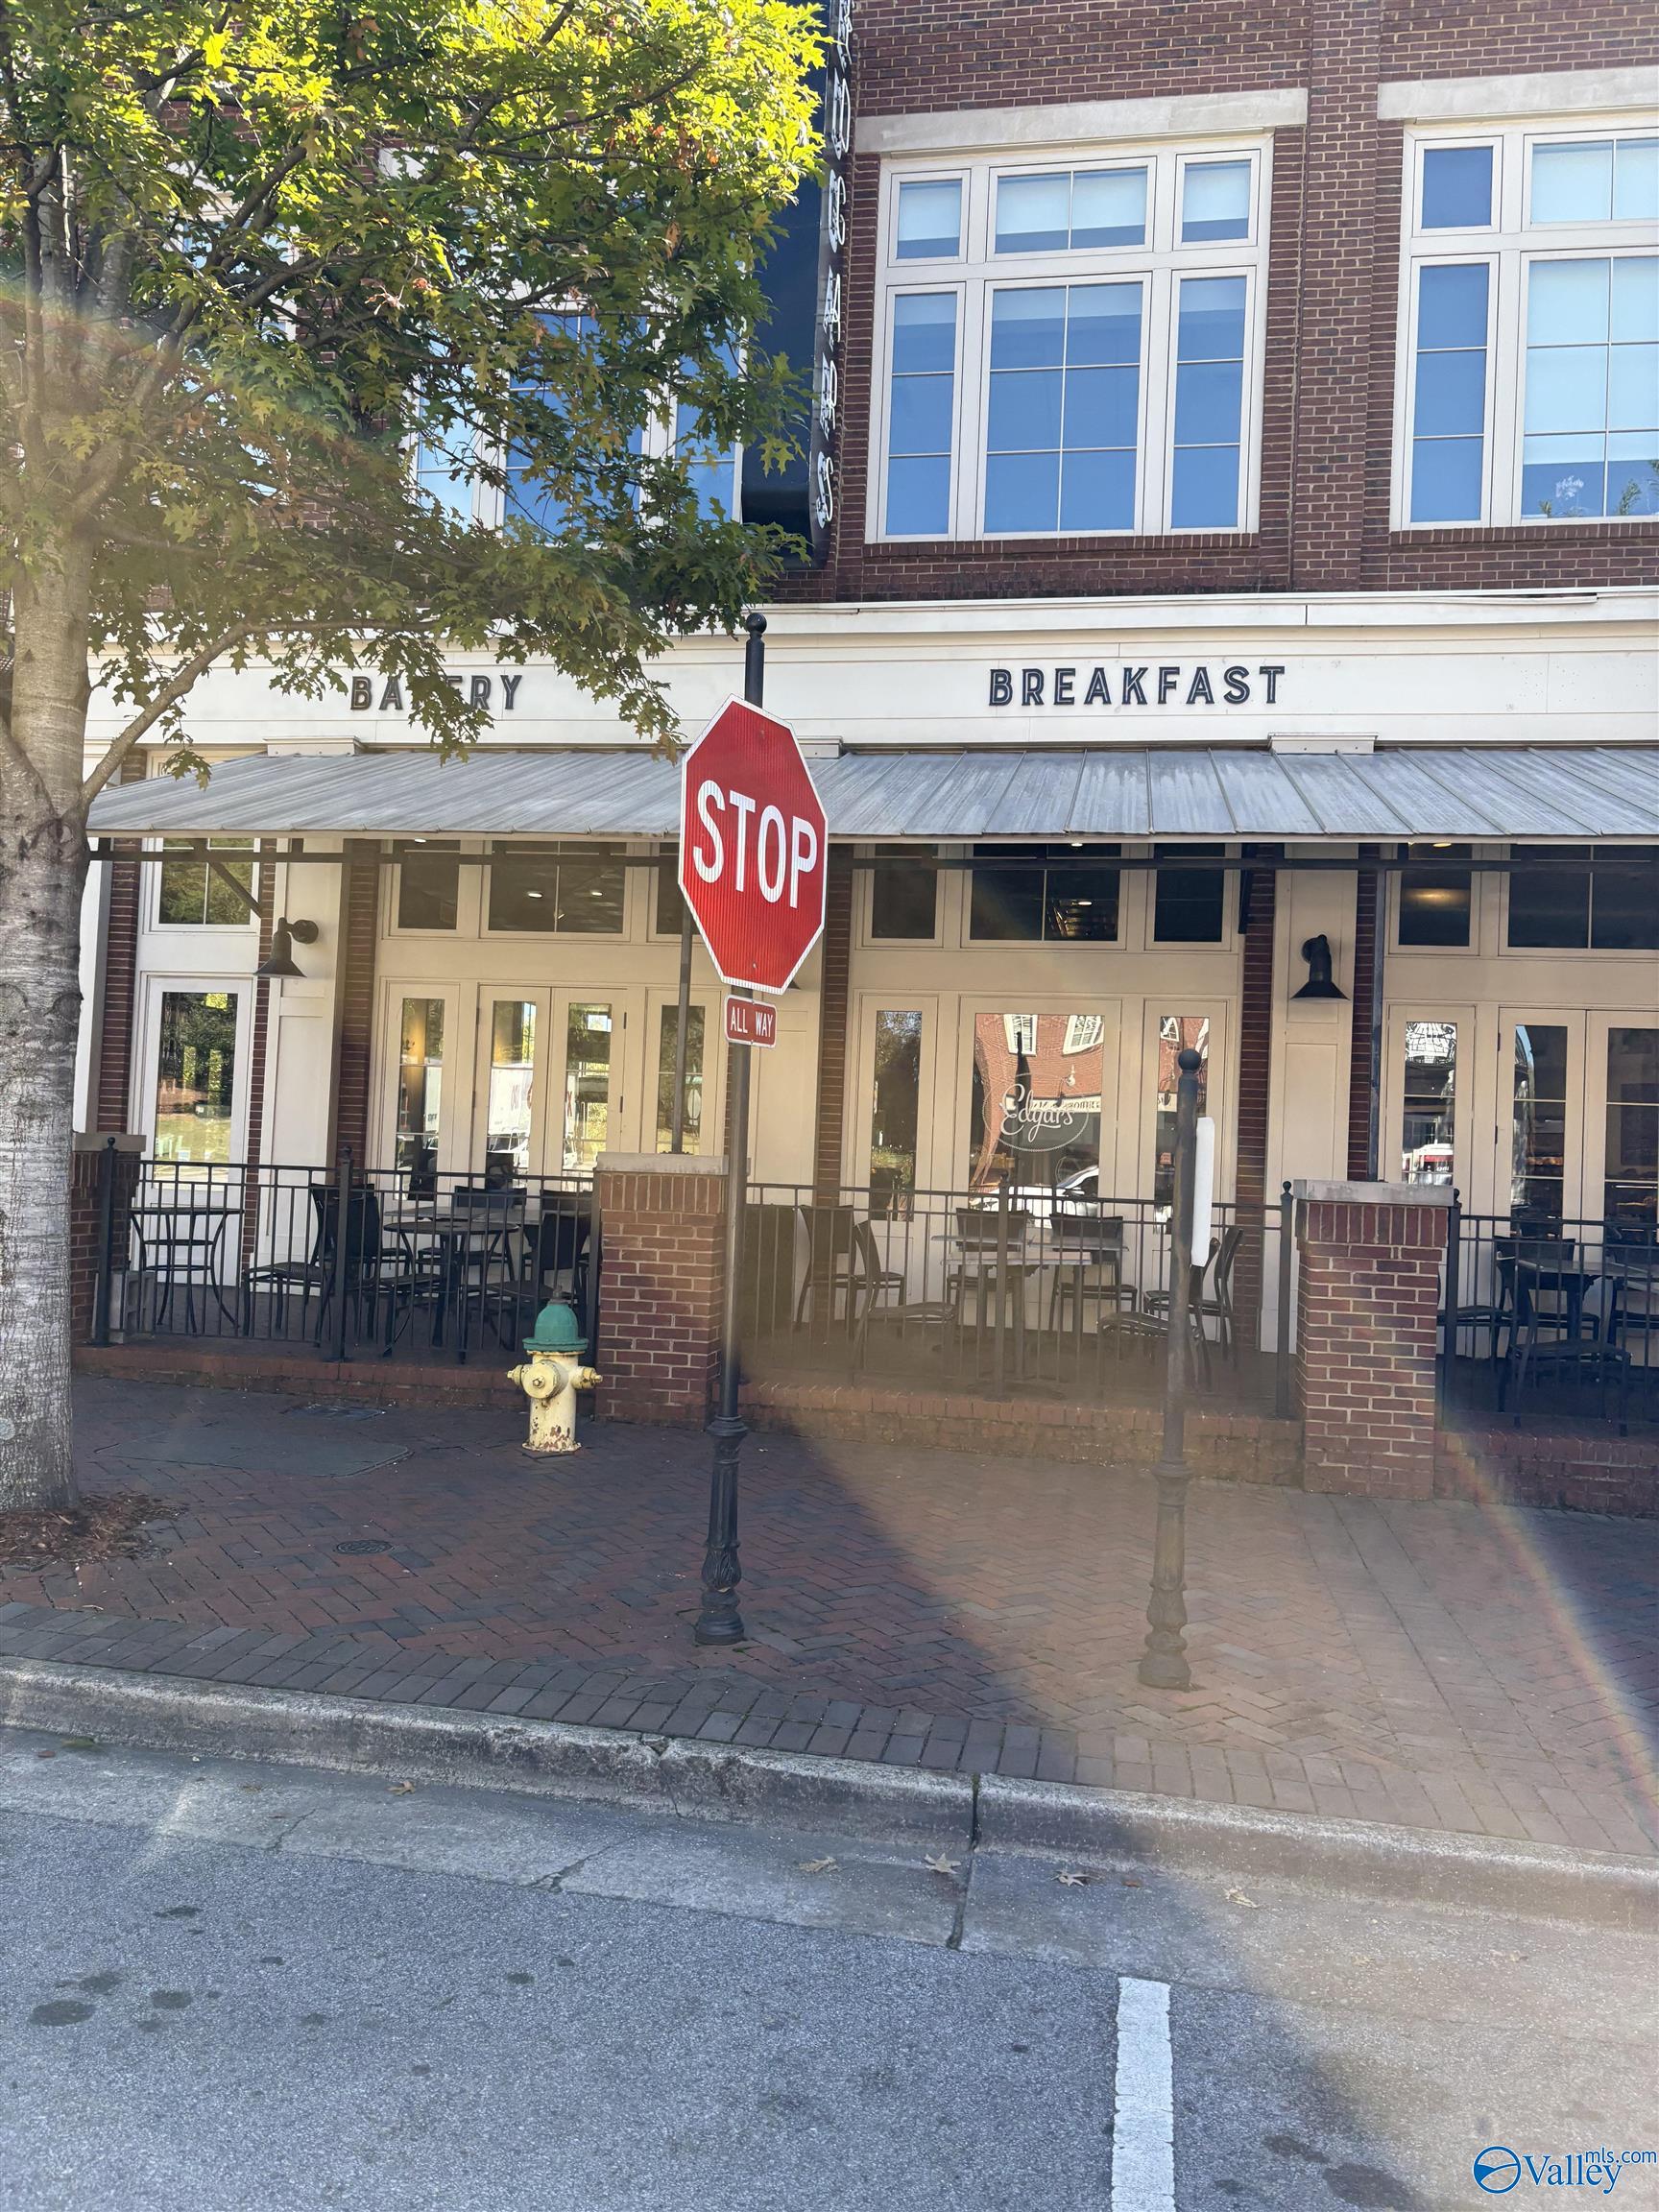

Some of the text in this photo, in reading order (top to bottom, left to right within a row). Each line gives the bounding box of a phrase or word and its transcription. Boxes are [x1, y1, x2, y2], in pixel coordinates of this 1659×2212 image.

[350, 675, 522, 710] BARY
[989, 665, 1286, 707] BREAKFAST
[693, 780, 818, 909] STOP
[730, 1006, 773, 1038] ALL WAY
